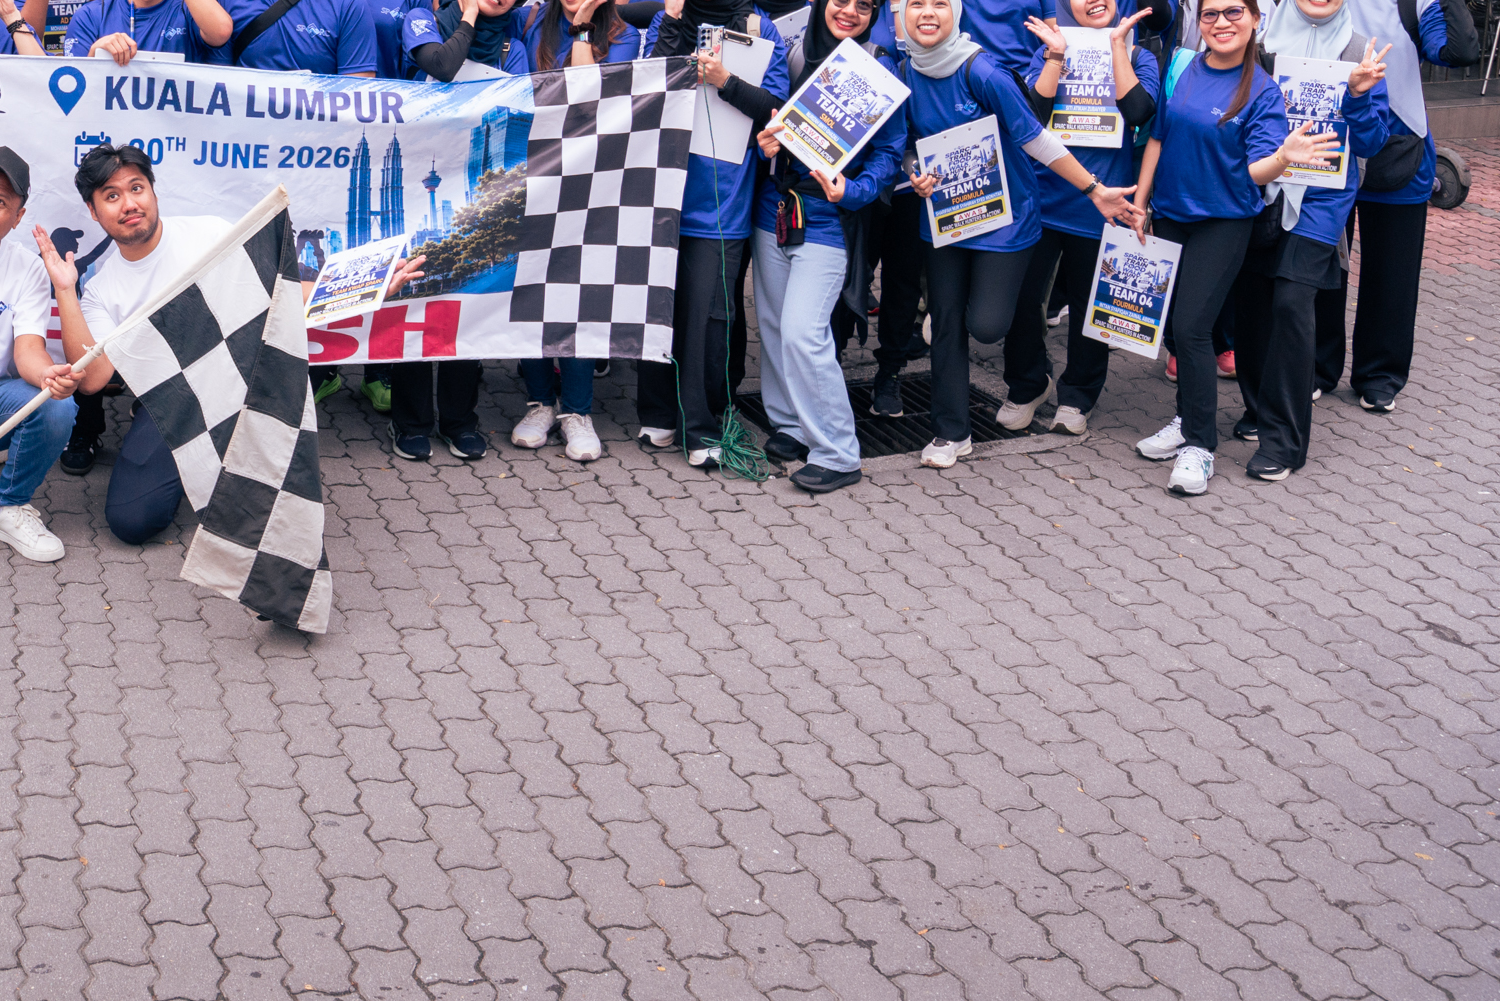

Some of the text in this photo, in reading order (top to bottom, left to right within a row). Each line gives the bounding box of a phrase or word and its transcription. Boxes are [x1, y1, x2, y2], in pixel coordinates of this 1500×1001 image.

[849, 71, 872, 90] SPARC
[850, 77, 869, 94] TRAIN
[845, 79, 865, 97] FOOD
[1065, 84, 1111, 97] TEAM 04
[105, 76, 404, 124] KUALA LUMPUR
[1300, 92, 1324, 100] FOOD
[816, 94, 845, 122] TEAM
[842, 114, 856, 132] 12
[819, 113, 836, 129] SMOL
[1322, 122, 1334, 133] 16
[803, 126, 826, 146] AWAS
[193, 140, 269, 169] JUNE
[278, 145, 350, 169] 2026
[945, 146, 970, 159] SPARC
[949, 151, 971, 162] TRAIN
[949, 156, 971, 167] FOOD
[943, 176, 990, 199] TEAM 04
[952, 190, 984, 205] FOURMULA
[959, 208, 983, 220] AWAS
[1124, 252, 1148, 262] SPARC
[1126, 258, 1148, 268] TRAIN
[1123, 263, 1146, 273] FOOD
[325, 273, 376, 292] OFFICIAL
[347, 283, 365, 292] KWAP
[365, 278, 384, 288] SPARC
[1109, 284, 1153, 308] TEAM 04
[1099, 302, 1111, 311] INTAN
[1113, 299, 1143, 314] FOURMULA
[1112, 318, 1136, 330] AWAS
